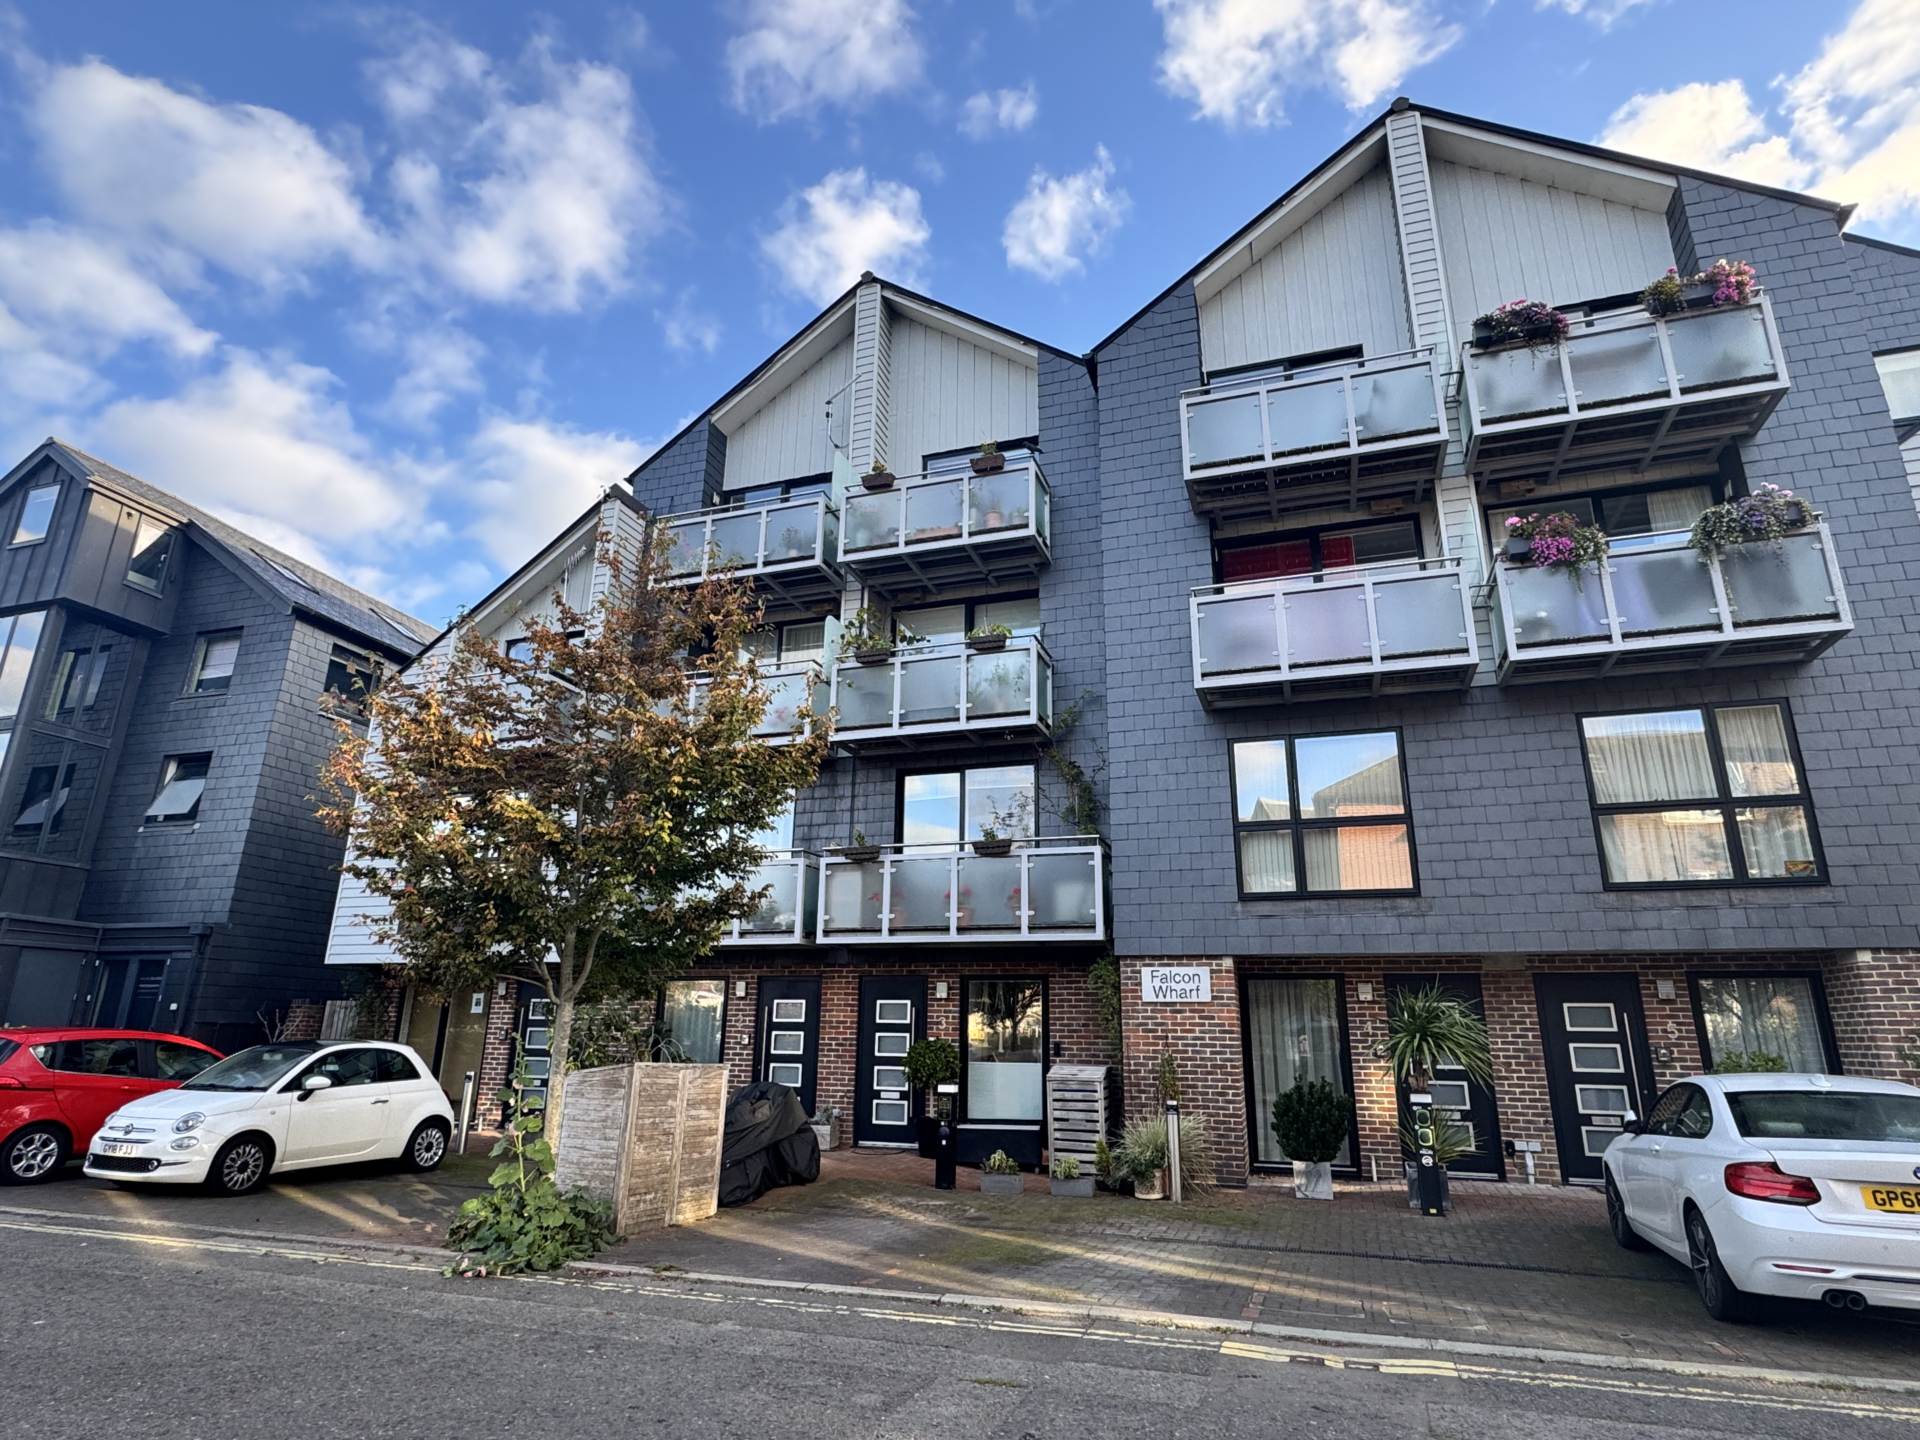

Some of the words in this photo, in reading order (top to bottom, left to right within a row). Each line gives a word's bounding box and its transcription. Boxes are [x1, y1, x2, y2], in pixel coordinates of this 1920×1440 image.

[1151, 969, 1201, 984] Falcon
[1152, 985, 1201, 999] Wharf
[938, 1016, 946, 1029] 3
[1363, 1021, 1373, 1035] 4
[1667, 1023, 1679, 1038] 5
